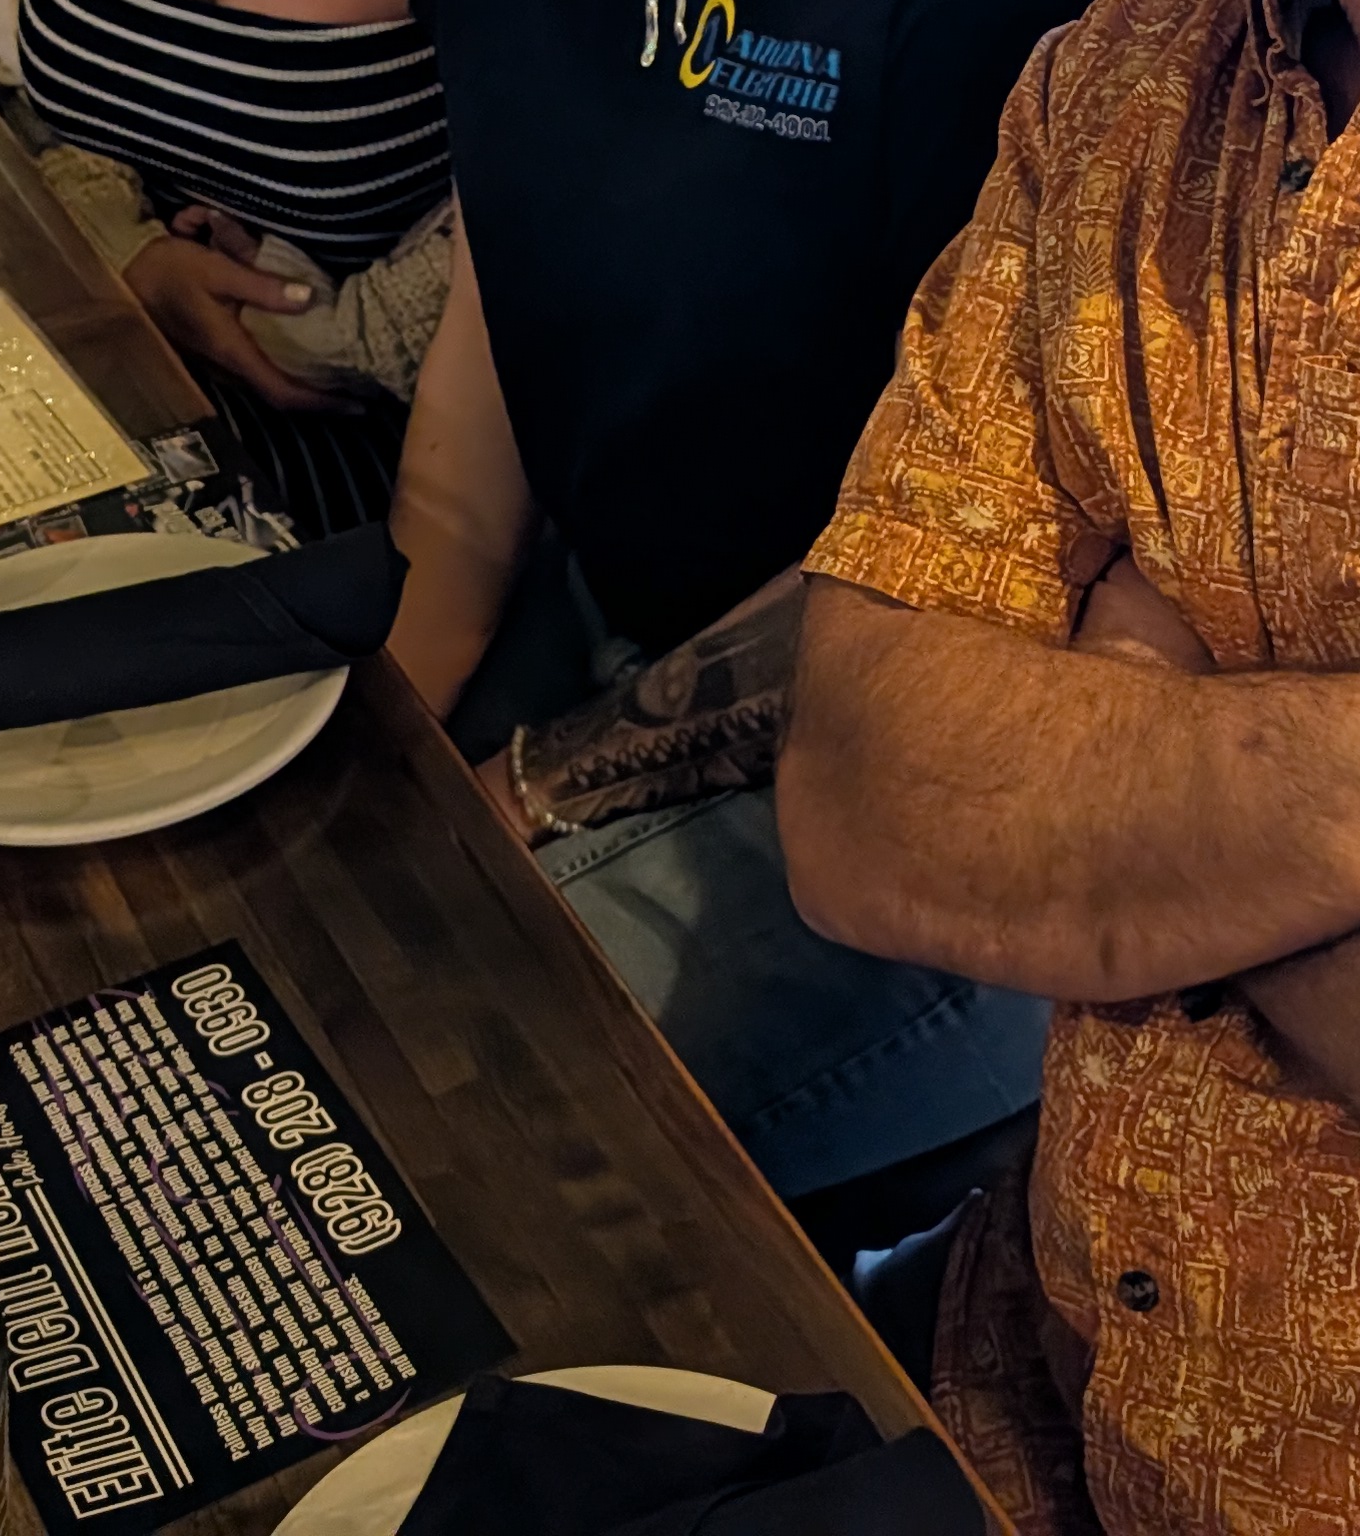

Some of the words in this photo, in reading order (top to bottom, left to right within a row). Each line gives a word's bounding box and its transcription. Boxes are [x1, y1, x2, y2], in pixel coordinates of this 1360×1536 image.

[171, 963, 270, 1056] 0930
[186, 1072, 209, 1094] door
[120, 1095, 139, 1113] the
[141, 1084, 172, 1123] remains
[200, 1094, 218, 1110] for
[241, 1070, 338, 1150] 208
[43, 1102, 74, 1142] restores
[75, 1111, 98, 1138] body
[161, 1121, 190, 1148] paint
[183, 1109, 209, 1139] retain
[209, 1108, 242, 1147] solution
[63, 1140, 86, 1164] that
[87, 1135, 126, 1186] traditional
[120, 1141, 136, 1155] to
[178, 1145, 209, 1183] custom
[202, 1140, 221, 1158] car
[231, 1145, 267, 1183] perfect
[2, 1149, 44, 1187] Lake
[77, 1162, 111, 1203] process
[128, 1155, 152, 1182] tools
[161, 1165, 191, 1197] gently
[214, 1160, 240, 1184] your
[117, 1184, 135, 1202] for
[199, 1182, 216, 1195] or
[230, 1185, 257, 1216] helps
[256, 1182, 276, 1201] the
[291, 1142, 402, 1255] (928)
[123, 1199, 150, 1227] need
[142, 1182, 186, 1239] specialized
[181, 1198, 213, 1232] panel,
[207, 1194, 239, 1233] factory
[267, 1200, 287, 1219] It's
[99, 1203, 146, 1270] revolutionary
[140, 1226, 161, 1246] the
[247, 1216, 271, 1238] and
[280, 1217, 313, 1259] repairs.
[178, 1240, 199, 1263] use
[203, 1235, 223, 1255] the
[229, 1231, 256, 1257] your
[265, 1239, 295, 1277] repair,
[137, 1269, 151, 1280] a
[149, 1243, 183, 1286] without
[214, 1257, 233, 1271] of
[244, 1255, 281, 1303] Because
[304, 1259, 330, 1288] shop
[142, 1280, 158, 1295] is
[191, 1264, 237, 1329] technicians
[227, 1275, 265, 1327] backside
[287, 1280, 321, 1322] cleaner
[321, 1287, 348, 1318] body
[344, 1273, 380, 1321] creases.
[147, 1293, 174, 1324] (PDR)
[174, 1284, 212, 1337] condition
[272, 1301, 307, 1348] smooth.
[163, 1323, 202, 1374] Removal
[226, 1329, 260, 1370] skilled
[258, 1329, 279, 1352] the
[312, 1324, 338, 1348] and
[336, 1315, 392, 1389] conventional
[371, 1321, 402, 1356] minor
[200, 1336, 237, 1382] original
[272, 1353, 299, 1385] from
[330, 1351, 361, 1388] faster
[390, 1353, 416, 1378] and
[190, 1372, 218, 1403] Dent
[228, 1382, 248, 1402] its
[252, 1372, 284, 1412] highly
[297, 1347, 345, 1412] completely
[354, 1389, 370, 1401] a
[238, 1400, 256, 1417] to
[289, 1387, 322, 1424] metal
[209, 1402, 249, 1460] Paintless
[245, 1415, 274, 1449] body
[274, 1413, 297, 1436] Our
[40, 1386, 164, 1520] Elite
